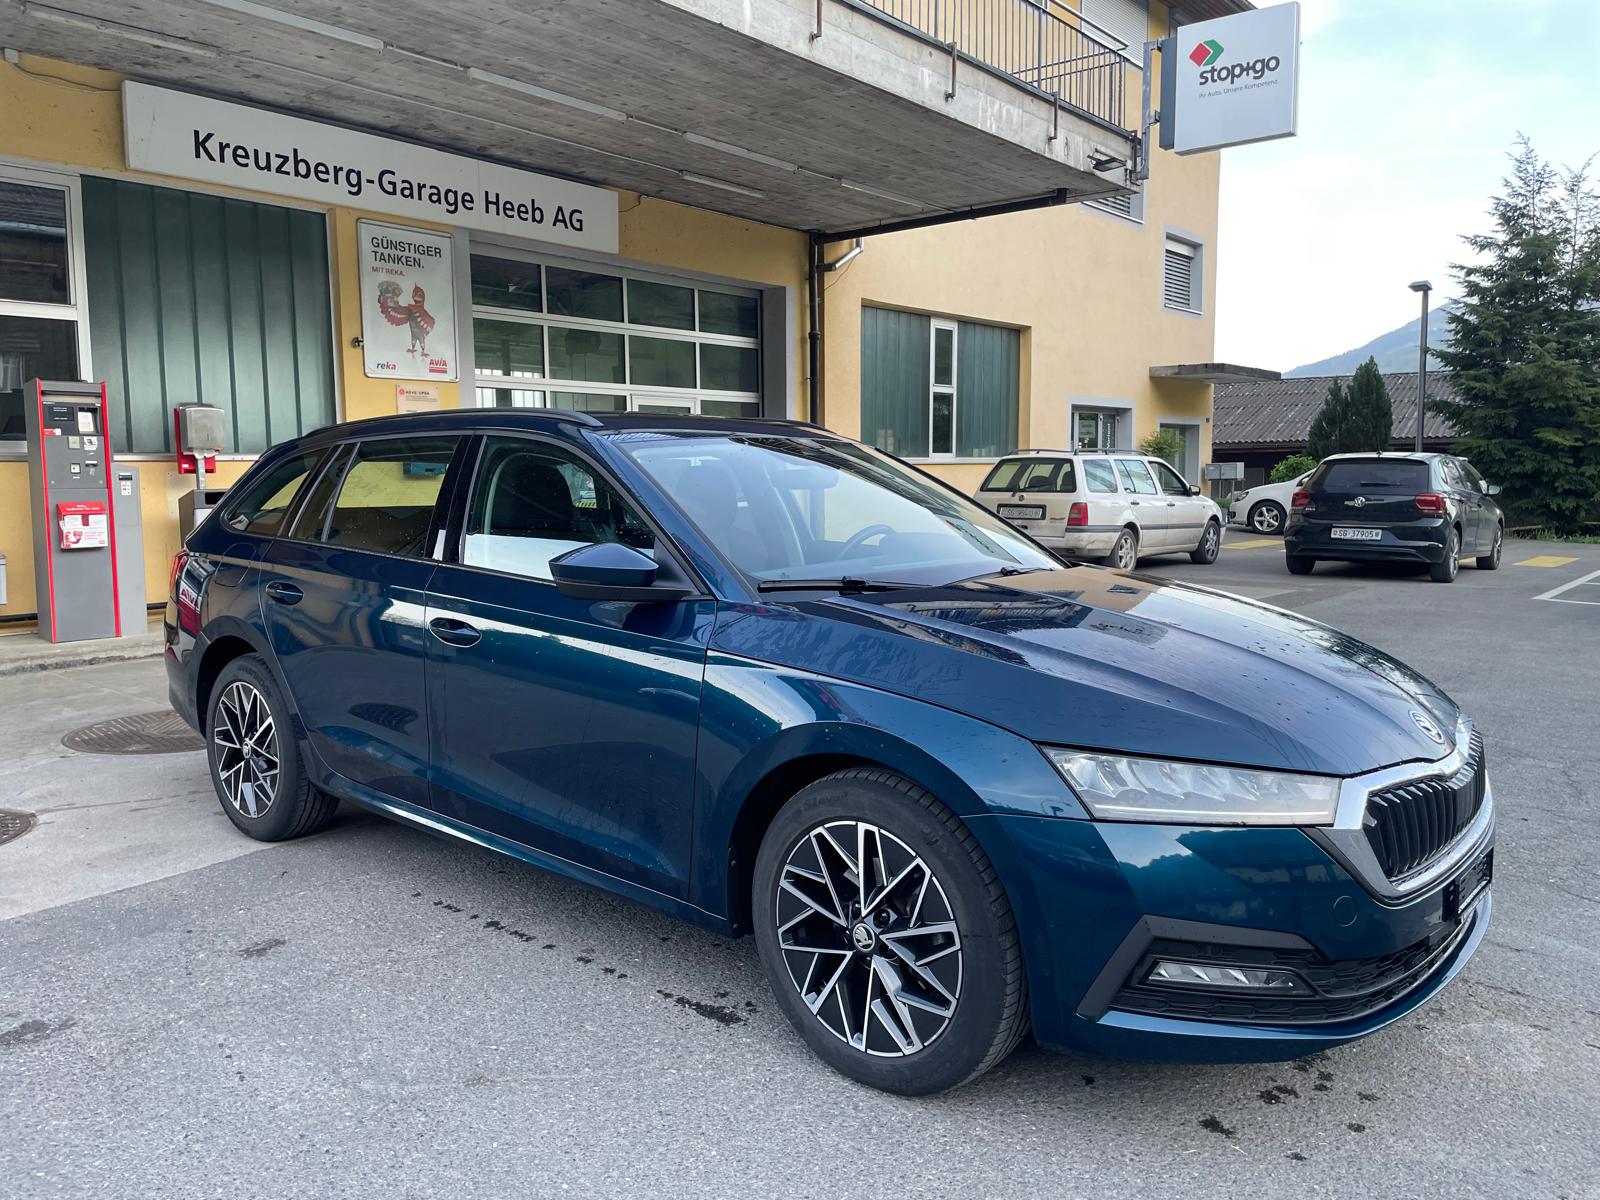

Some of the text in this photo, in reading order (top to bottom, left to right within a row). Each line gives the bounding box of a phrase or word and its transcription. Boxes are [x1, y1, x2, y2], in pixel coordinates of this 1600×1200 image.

[1199, 56, 1280, 85] stop+go
[1223, 86, 1244, 94] Unsere
[193, 128, 584, 233] Kreuzberg-Garage Heeb AG
[371, 236, 442, 258] GÜNSTIGER
[371, 250, 424, 269] TANKEN.
[376, 361, 397, 371] reka
[429, 358, 448, 367] AVIA
